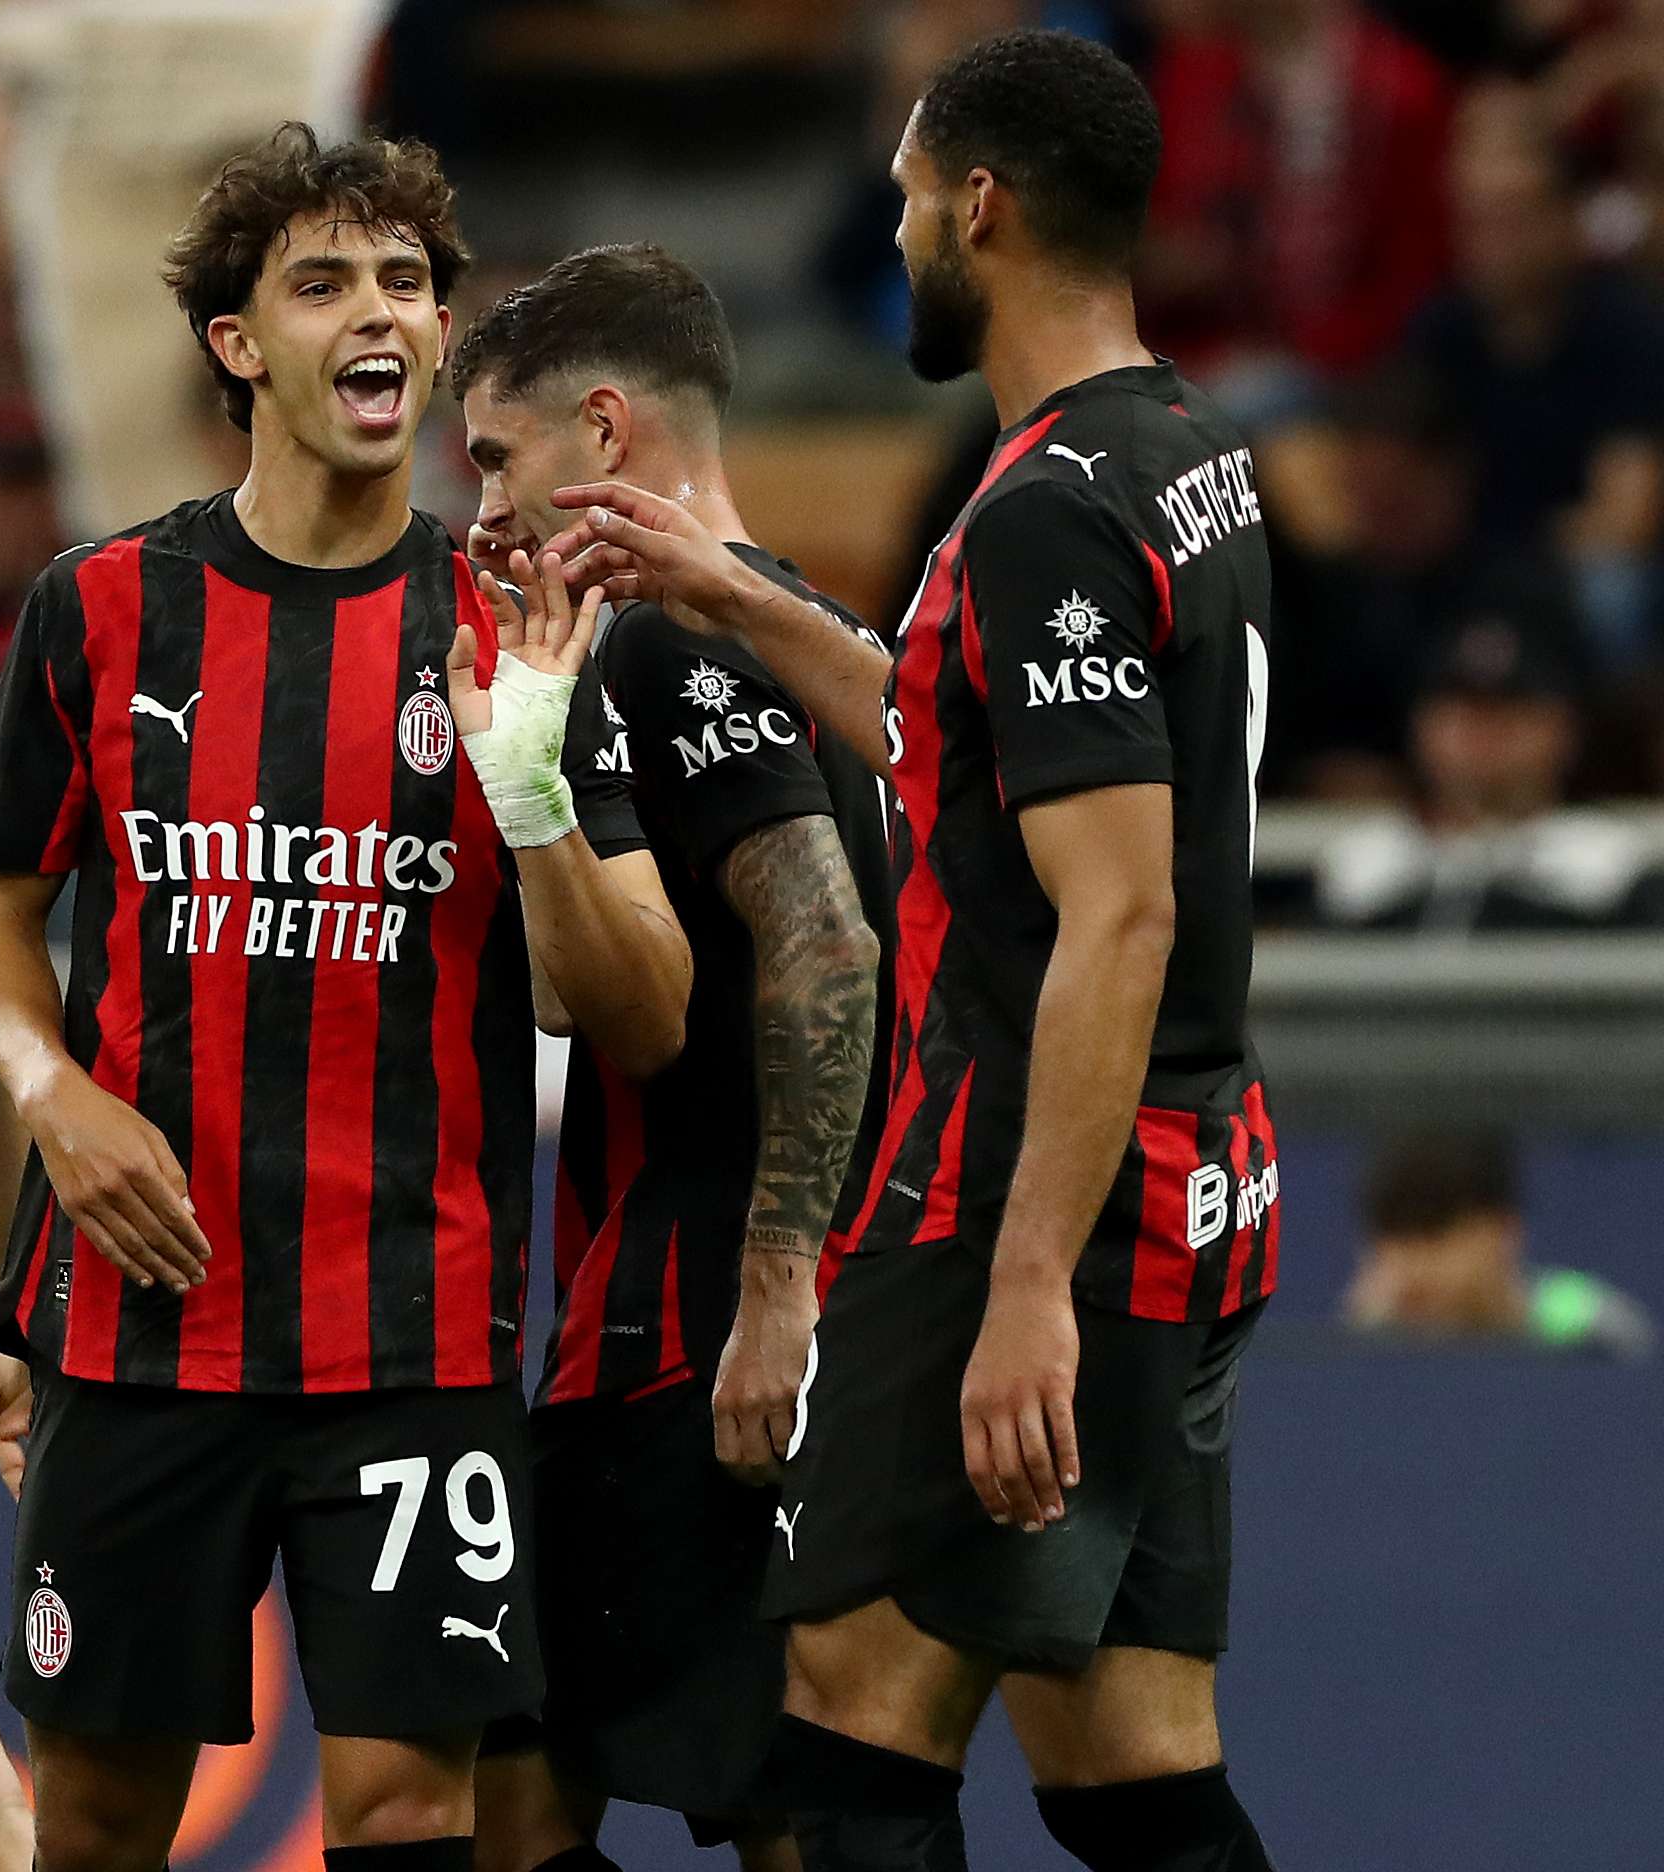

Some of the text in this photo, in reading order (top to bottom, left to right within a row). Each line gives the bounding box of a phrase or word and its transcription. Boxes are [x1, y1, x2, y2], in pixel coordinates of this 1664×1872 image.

[412, 699, 442, 717] ACM
[1022, 656, 1149, 708] MSC
[670, 706, 798, 779] MSC
[119, 805, 458, 893] Emirates
[166, 895, 407, 962] FLY BETTER
[359, 1450, 515, 1592] 79
